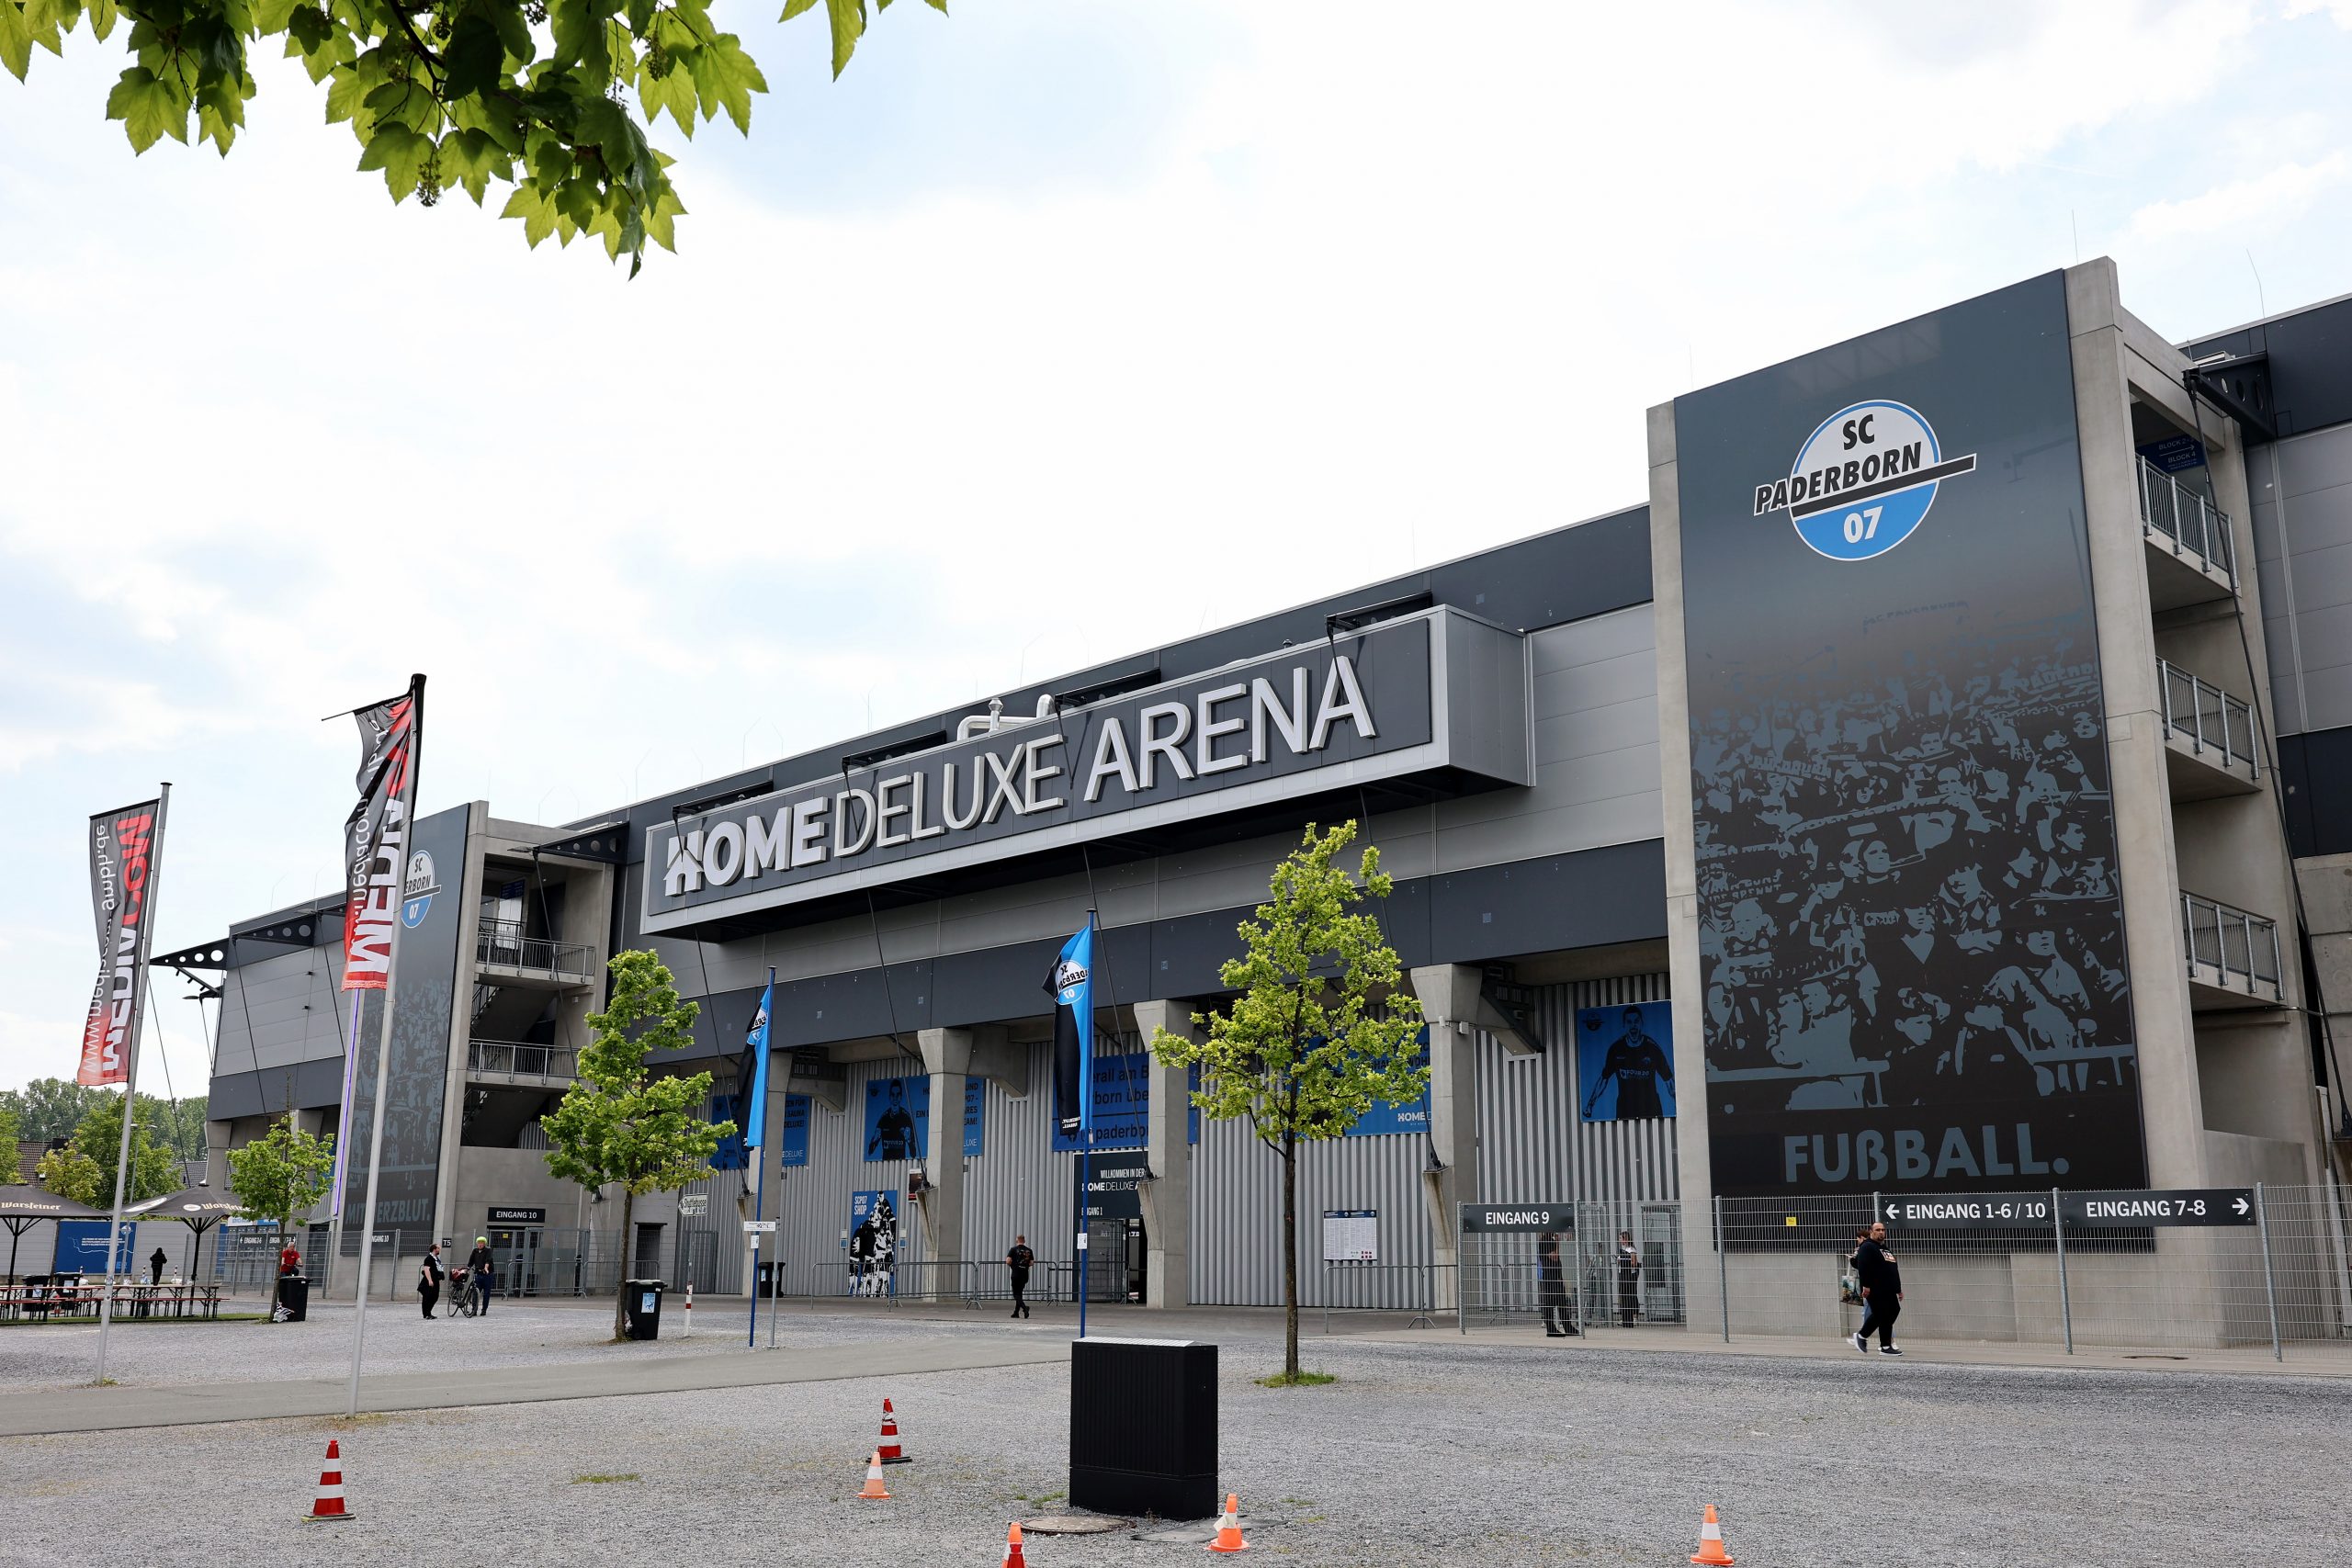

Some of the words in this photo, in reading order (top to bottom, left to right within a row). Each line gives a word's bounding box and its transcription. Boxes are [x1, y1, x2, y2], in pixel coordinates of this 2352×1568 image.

[1842, 414, 1875, 450] SC
[1755, 441, 1921, 513] PADERBORN
[1843, 505, 1883, 544] 07
[1084, 655, 1376, 803] ARENA
[414, 857, 423, 873] SC
[404, 874, 431, 895] ERBORN
[409, 903, 419, 919] 07
[1784, 1122, 2070, 1183] FUßBALL.
[1100, 1168, 1129, 1179] WILLKOMMEN
[1130, 1168, 1135, 1178] IN
[1, 1201, 62, 1210] Warsteiner
[854, 1195, 867, 1205] SCP07
[2086, 1201, 2171, 1218] EINGANG
[2174, 1200, 2206, 1216] 7-8
[345, 1202, 368, 1224] MIT
[376, 1198, 431, 1224] ERZBLUT.
[496, 1211, 527, 1219] EINGANG
[854, 1204, 867, 1215] SHOP
[1486, 1212, 1539, 1225] EINGANG
[1541, 1211, 1550, 1224] 9
[1906, 1202, 1981, 1220] EINGANG
[1984, 1202, 2011, 1220] 1-6
[2026, 1201, 2046, 1219] 10
